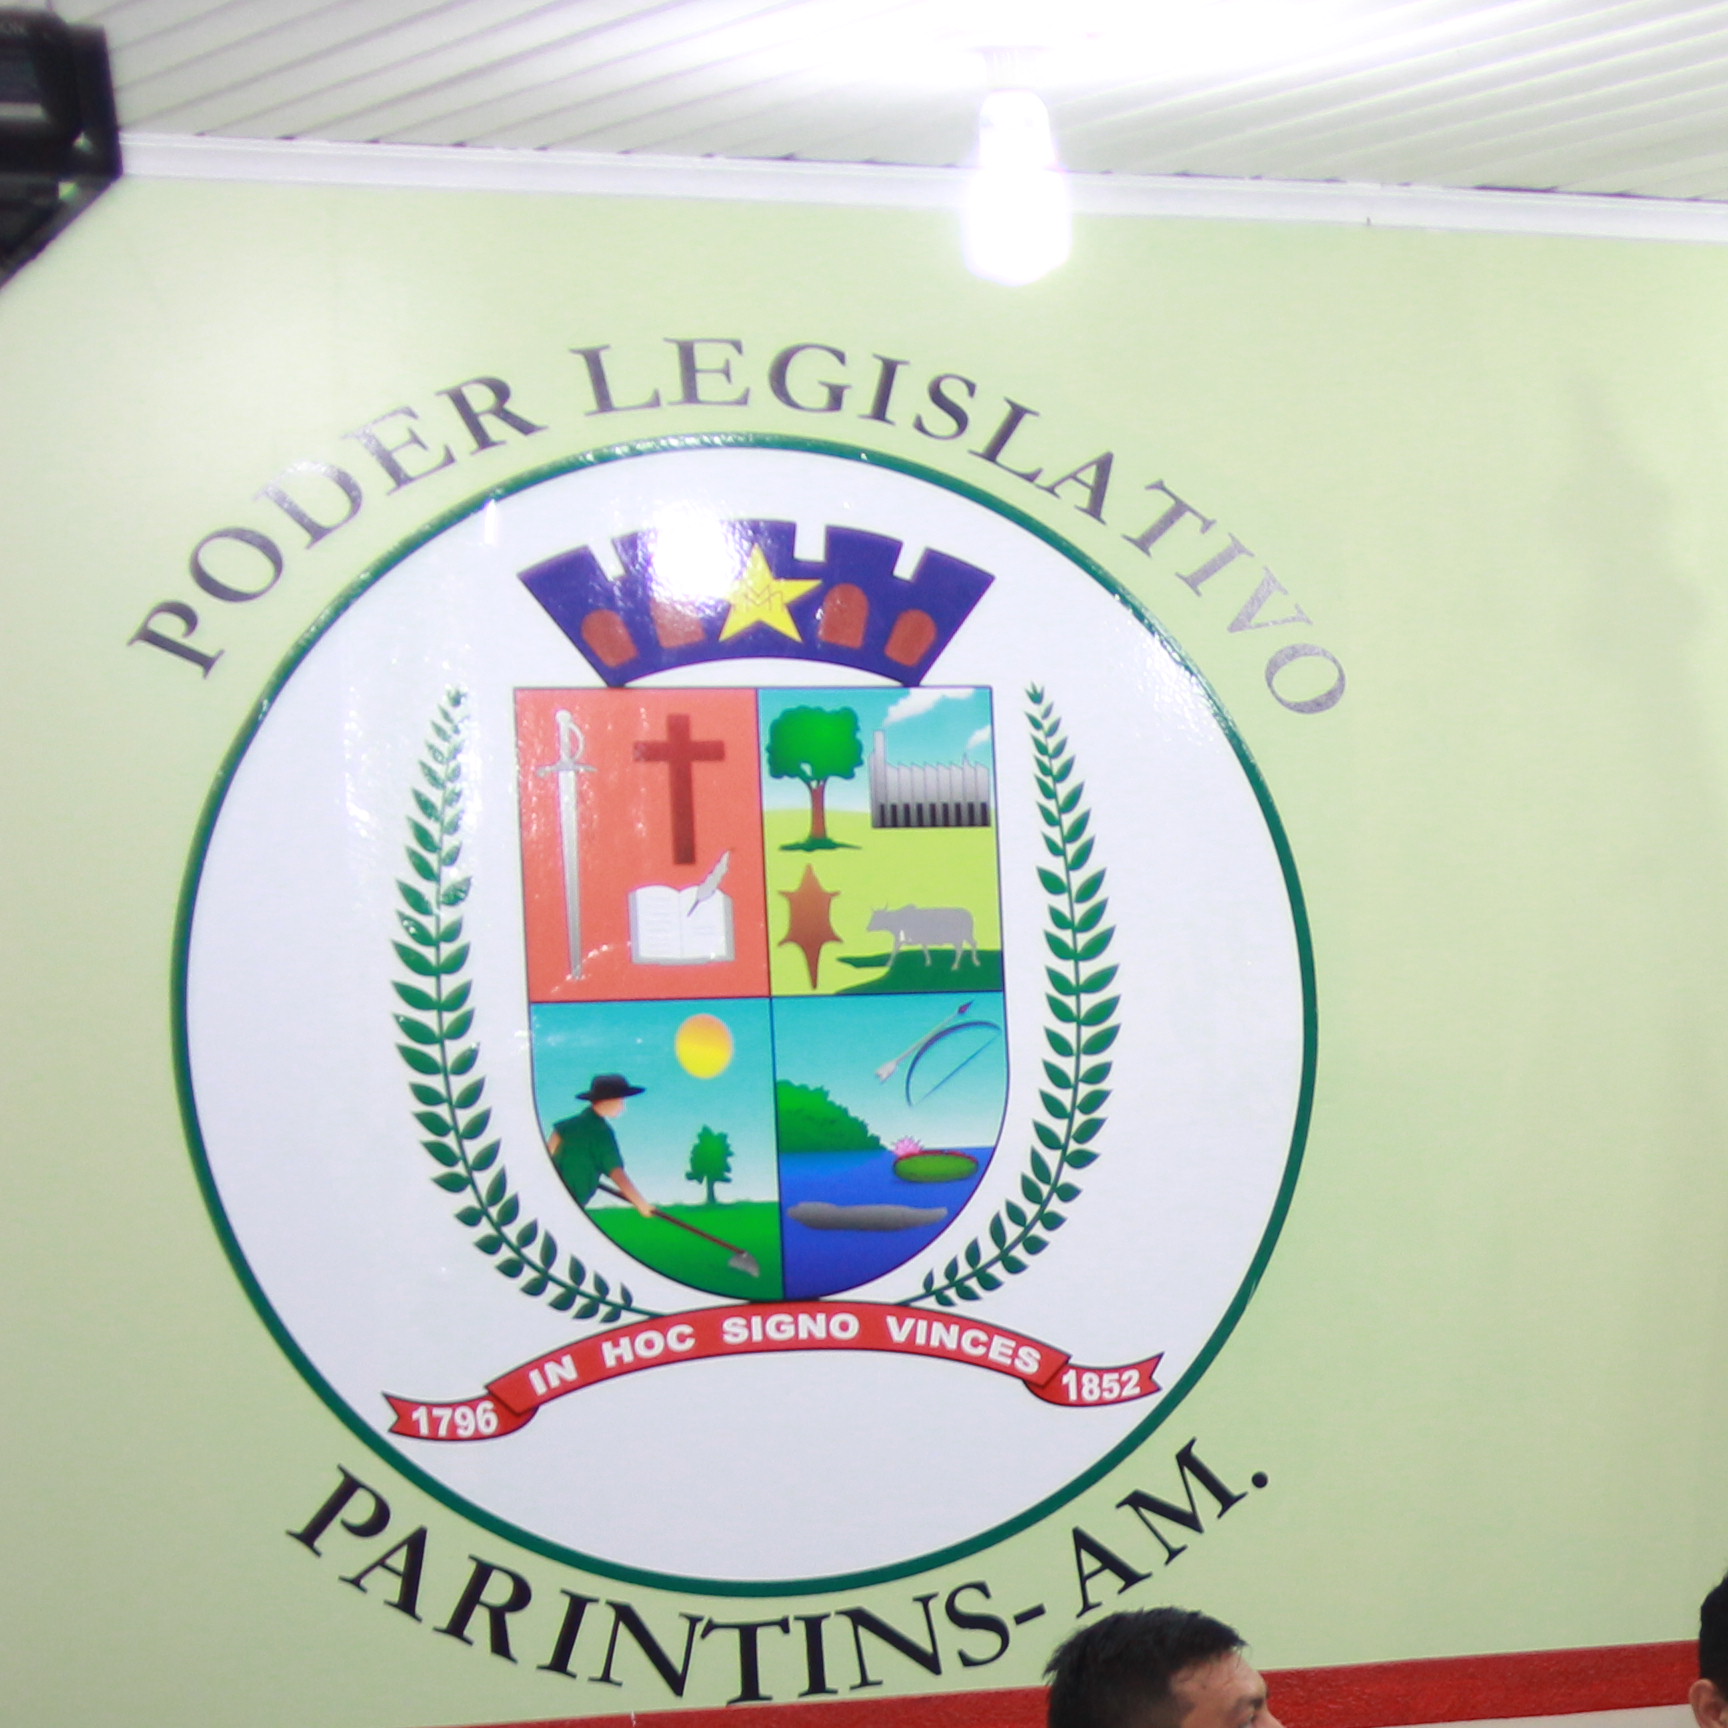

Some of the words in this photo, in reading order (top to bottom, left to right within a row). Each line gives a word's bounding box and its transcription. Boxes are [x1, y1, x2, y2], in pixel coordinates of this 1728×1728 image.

[127, 373, 547, 678] PODER
[569, 337, 1347, 716] LEGISLATIVO
[410, 1401, 498, 1438] 1796
[528, 1354, 578, 1396] IN
[602, 1324, 696, 1368] HOC
[722, 1312, 860, 1344] SIGNO
[886, 1315, 1042, 1374] VINCES
[1061, 1369, 1141, 1402] 1852
